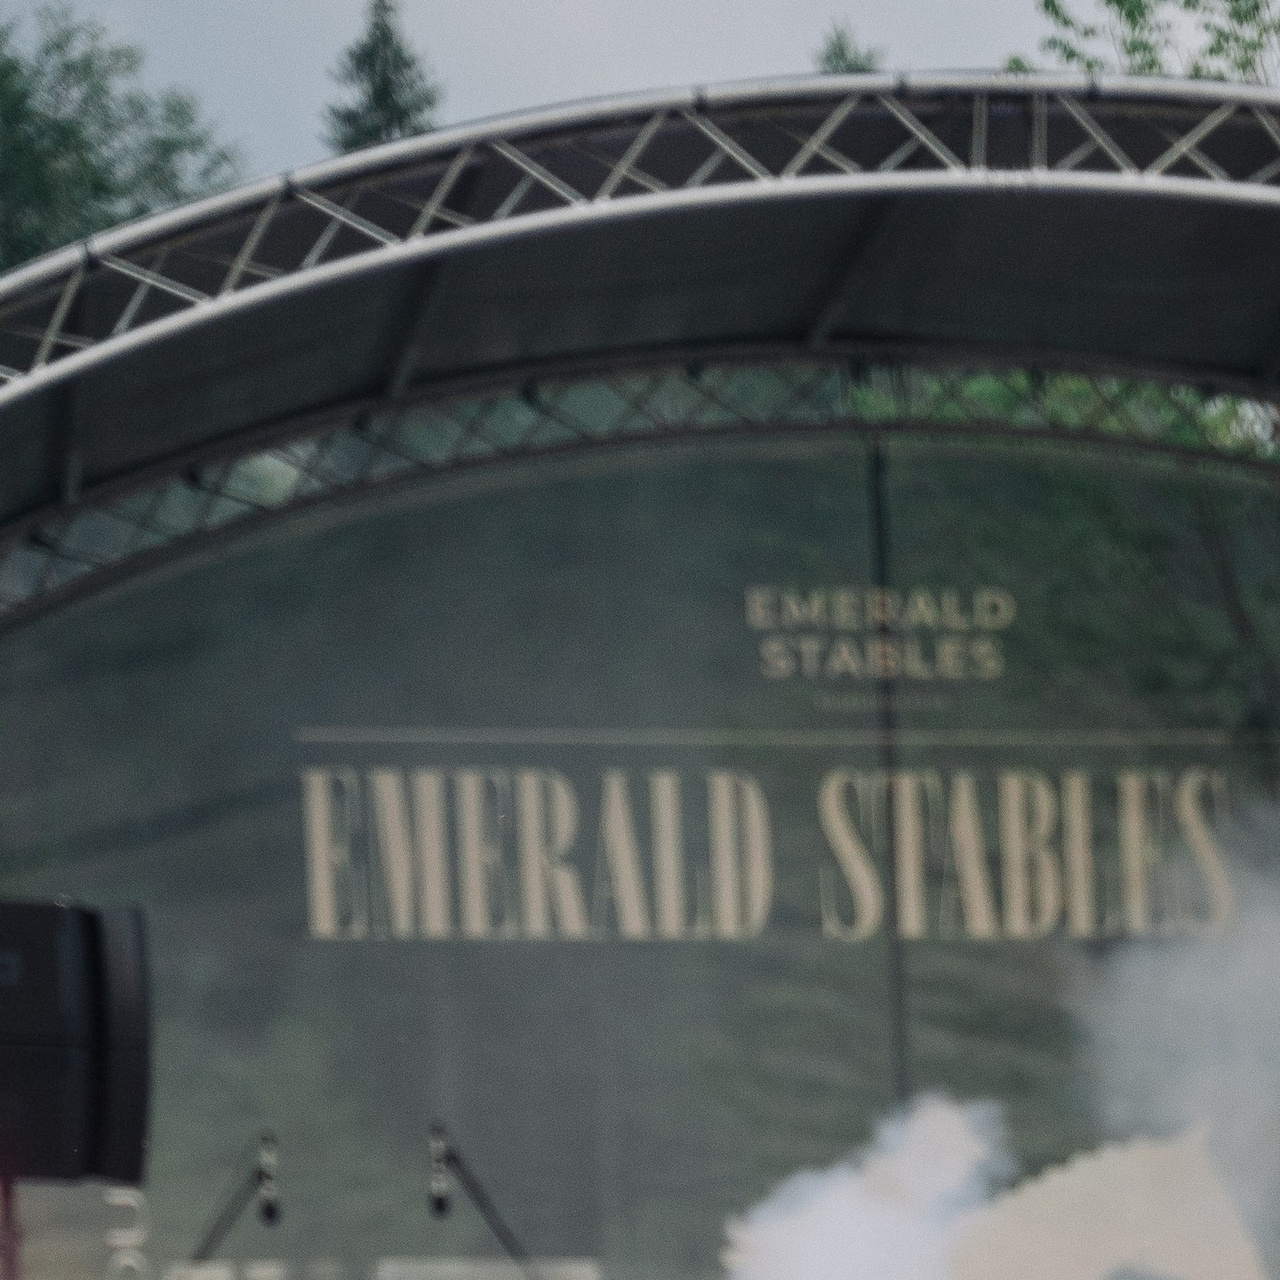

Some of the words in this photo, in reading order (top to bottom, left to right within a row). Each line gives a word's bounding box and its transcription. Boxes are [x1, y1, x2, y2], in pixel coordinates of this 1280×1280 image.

[746, 587, 1016, 632] EMERALD
[759, 635, 1004, 679] STABLES
[299, 764, 774, 942] EMERALD
[817, 764, 1238, 942] STABLES
